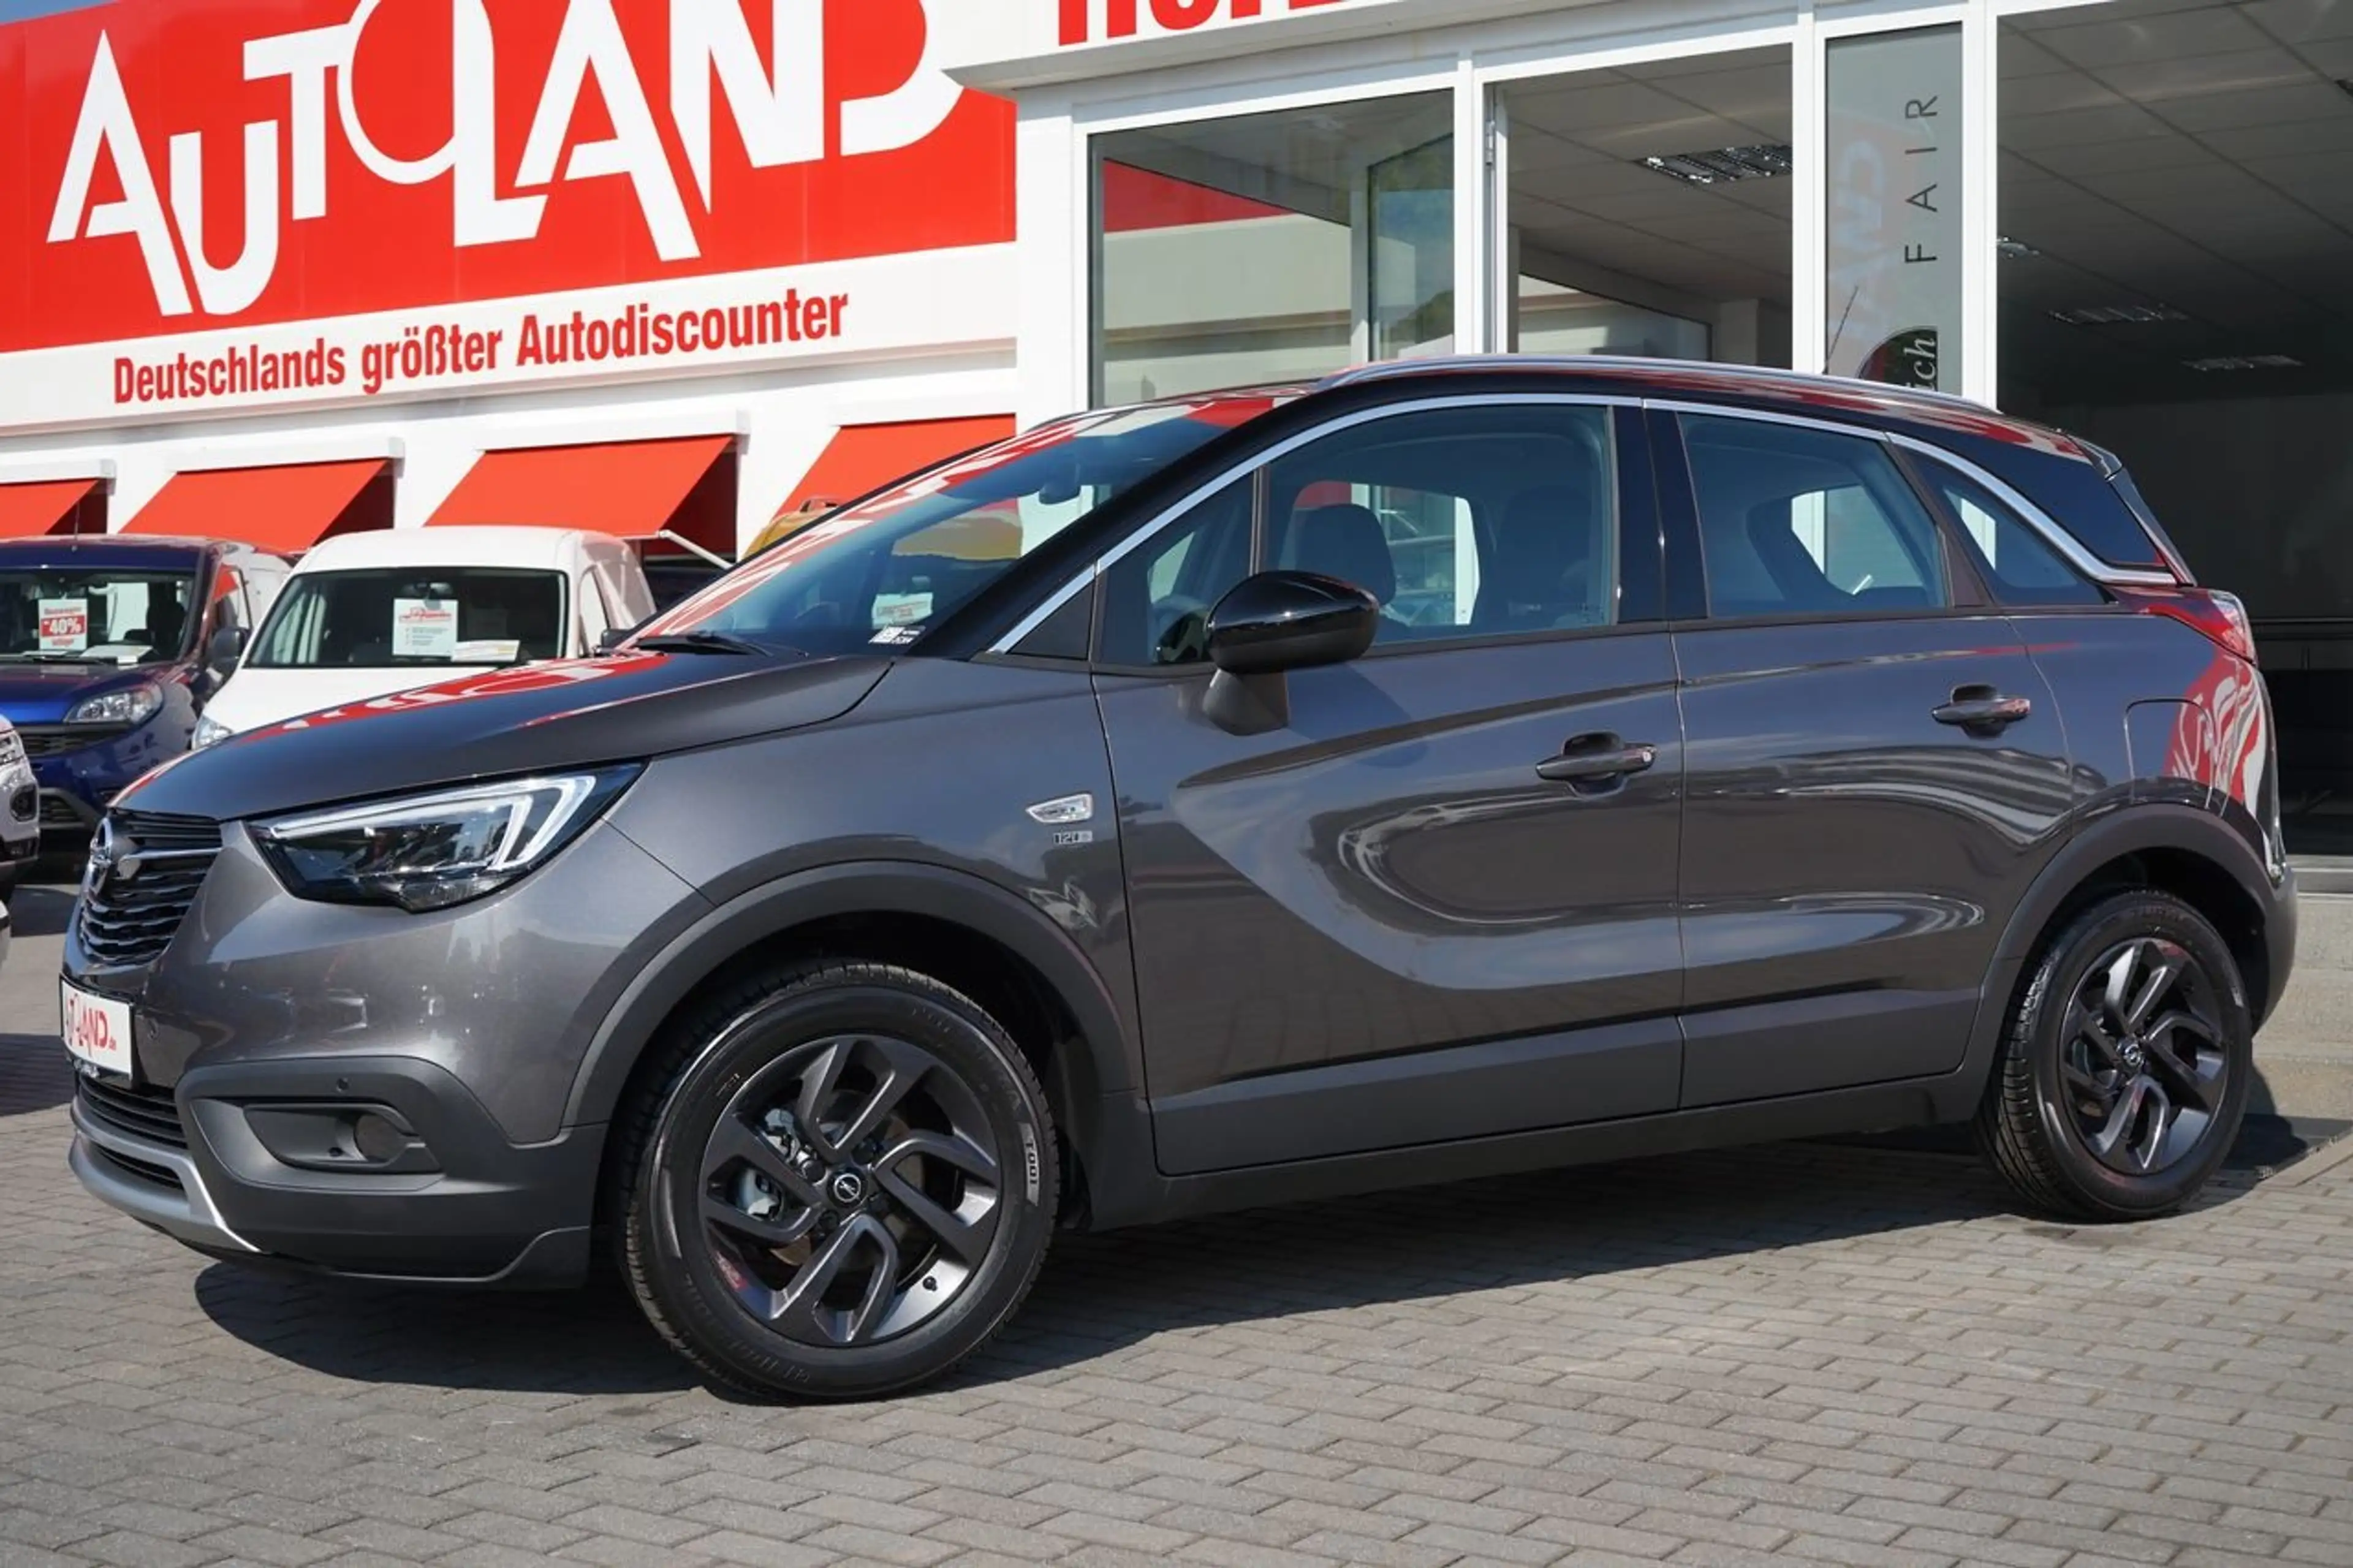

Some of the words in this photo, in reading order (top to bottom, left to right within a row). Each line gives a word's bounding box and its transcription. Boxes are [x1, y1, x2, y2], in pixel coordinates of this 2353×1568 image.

[1904, 94, 1938, 263] FAIR
[114, 337, 345, 404] Deutschlands
[360, 324, 502, 393] größter
[516, 288, 848, 366] Autodiscounter
